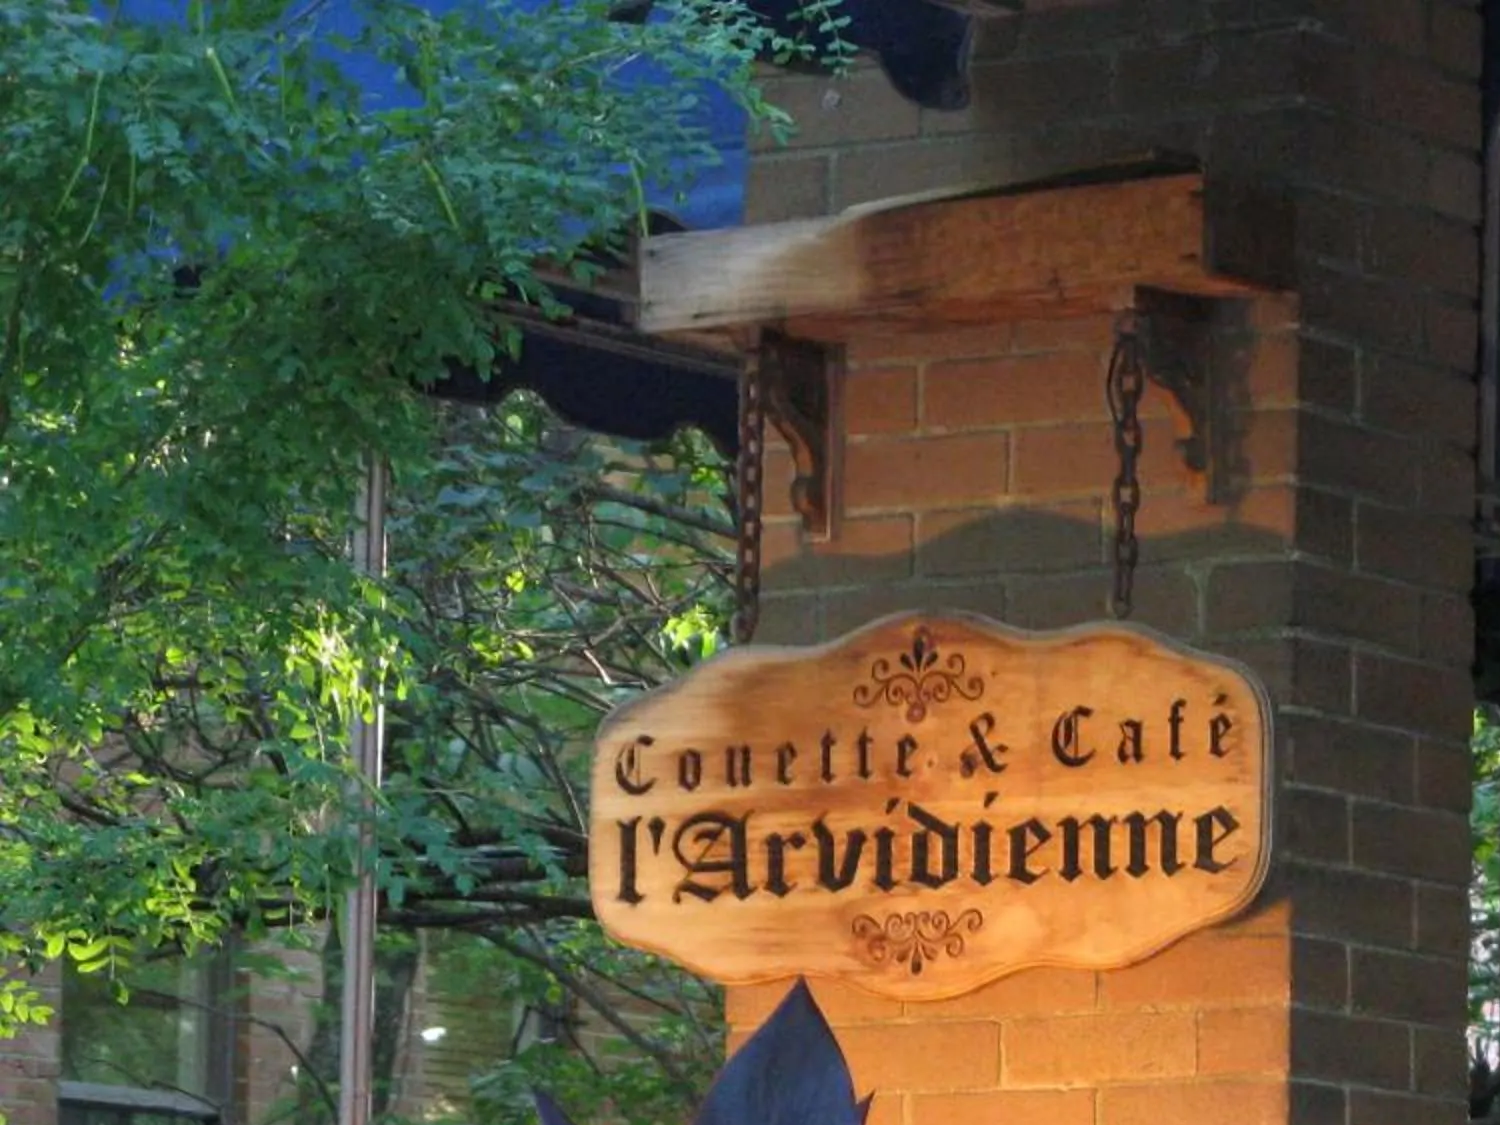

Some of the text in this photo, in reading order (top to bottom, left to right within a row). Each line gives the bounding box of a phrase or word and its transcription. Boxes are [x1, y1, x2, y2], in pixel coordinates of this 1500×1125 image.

[615, 694, 1234, 795] Couette & Café
[615, 792, 1241, 905] l'Arvidienne
